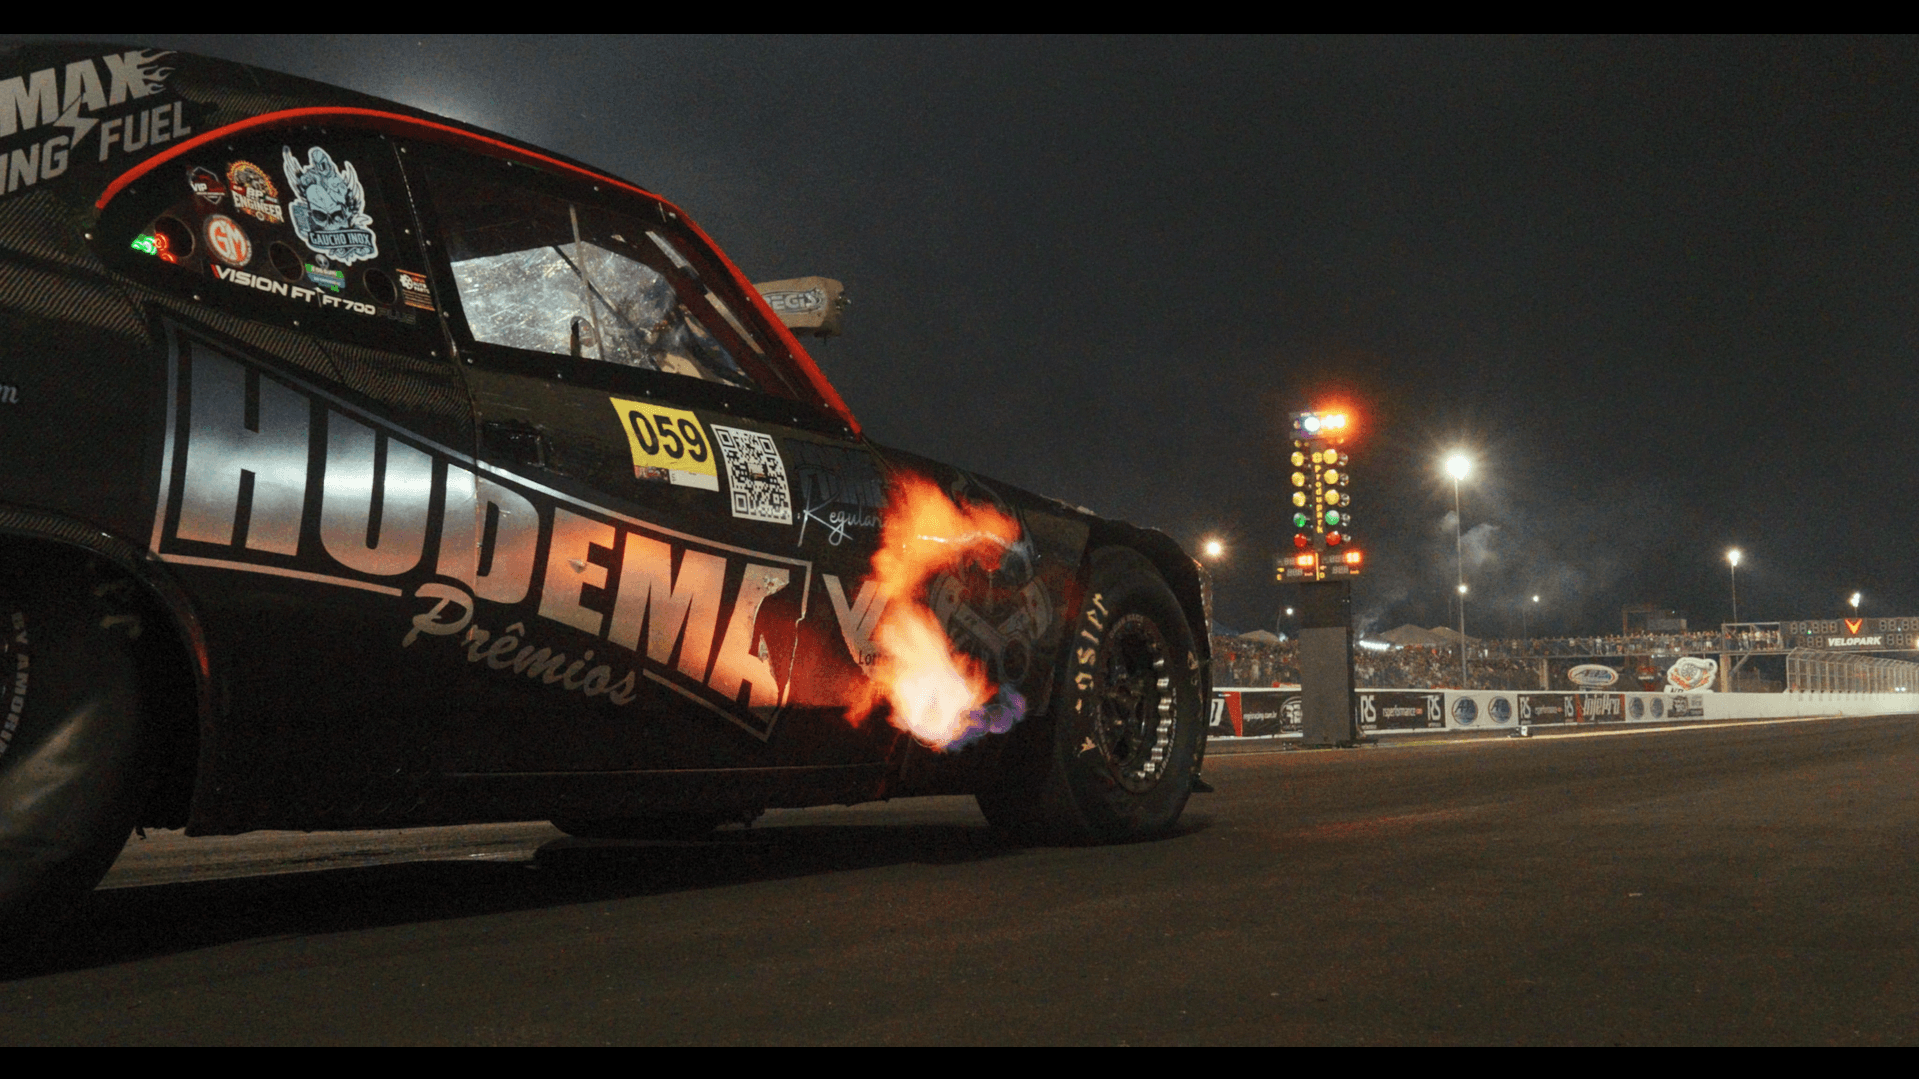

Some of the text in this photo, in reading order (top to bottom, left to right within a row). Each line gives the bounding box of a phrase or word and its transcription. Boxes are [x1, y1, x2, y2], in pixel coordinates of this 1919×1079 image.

[0, 50, 160, 137] MAX
[99, 101, 191, 162] FUEL
[231, 190, 284, 223] ENGINEER
[309, 233, 372, 246] GAUCHO INOX
[215, 264, 288, 296] VISION
[290, 285, 315, 303] FT
[322, 294, 376, 316] FT700
[628, 410, 708, 463] 059
[402, 583, 636, 706] Prêmios
[1828, 636, 1882, 647] VELOPARK
